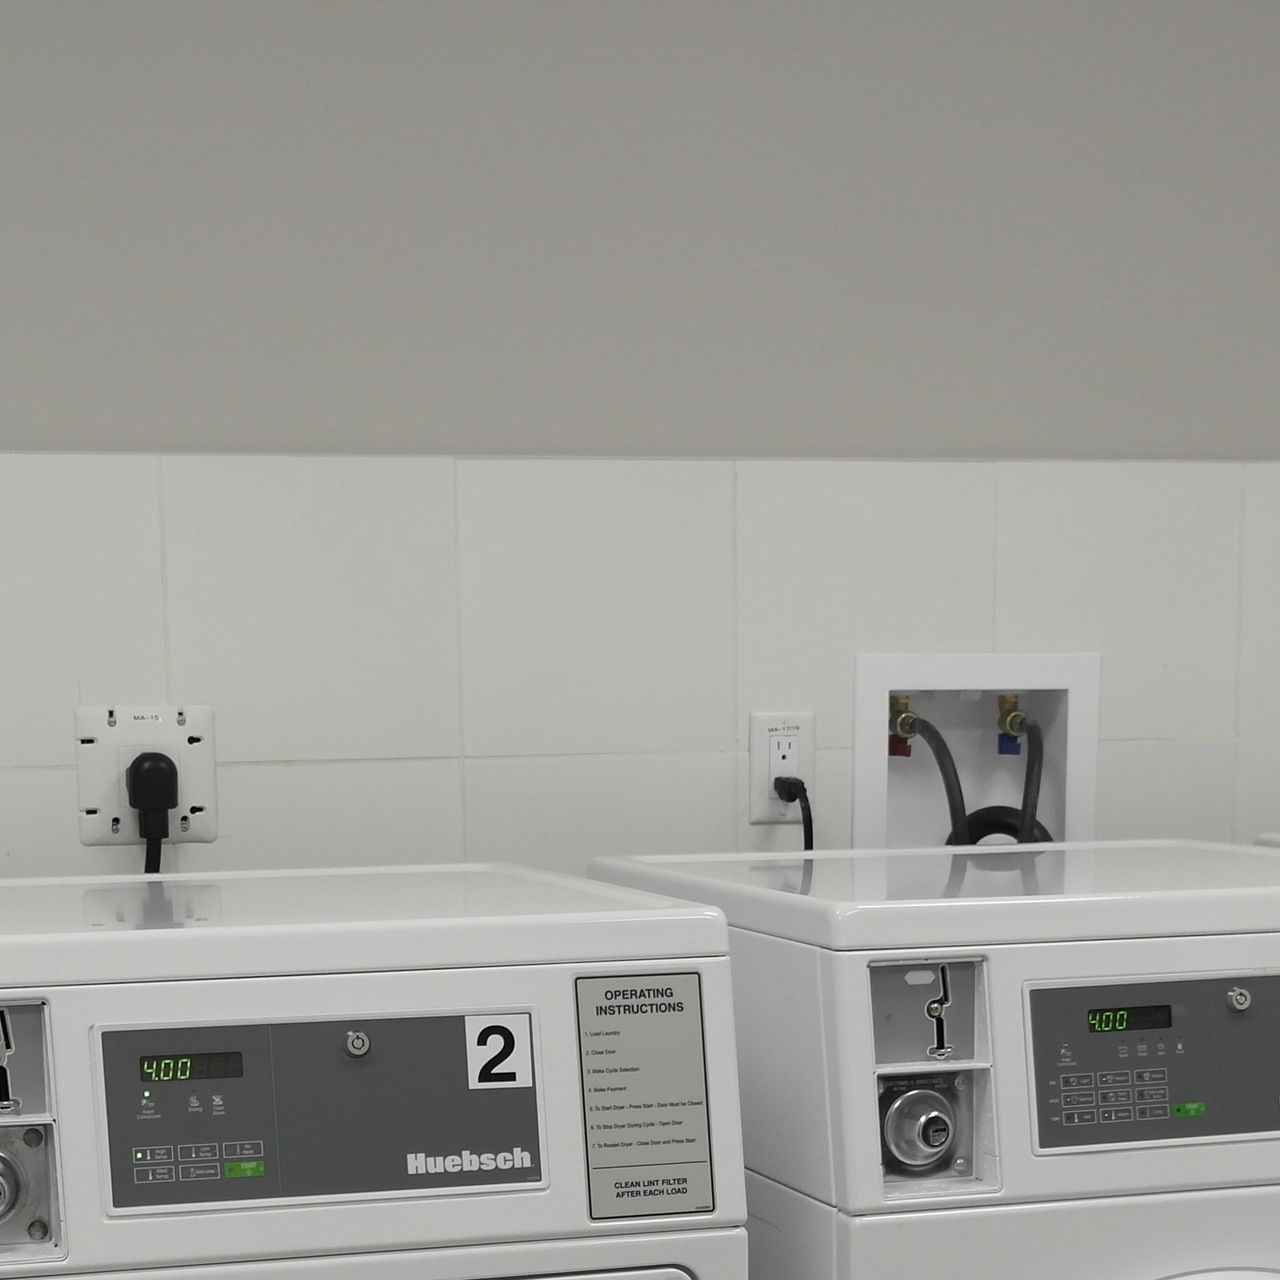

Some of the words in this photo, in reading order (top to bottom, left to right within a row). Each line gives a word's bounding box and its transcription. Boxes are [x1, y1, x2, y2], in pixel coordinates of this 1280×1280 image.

[604, 987, 674, 1001] OPERATING
[595, 1001, 684, 1016] INSTRUCTIONS
[1088, 1011, 1127, 1031] 4.00
[477, 1024, 517, 1083] 2
[143, 1058, 191, 1081] 4.00
[405, 1147, 531, 1175] Huebsch
[614, 1180, 641, 1189] CLEAN
[642, 1179, 659, 1187] LINT
[661, 1178, 688, 1187] FILTER
[615, 1190, 641, 1199] AFTER
[643, 1188, 665, 1197] EACH
[666, 1187, 688, 1196] LOAD
